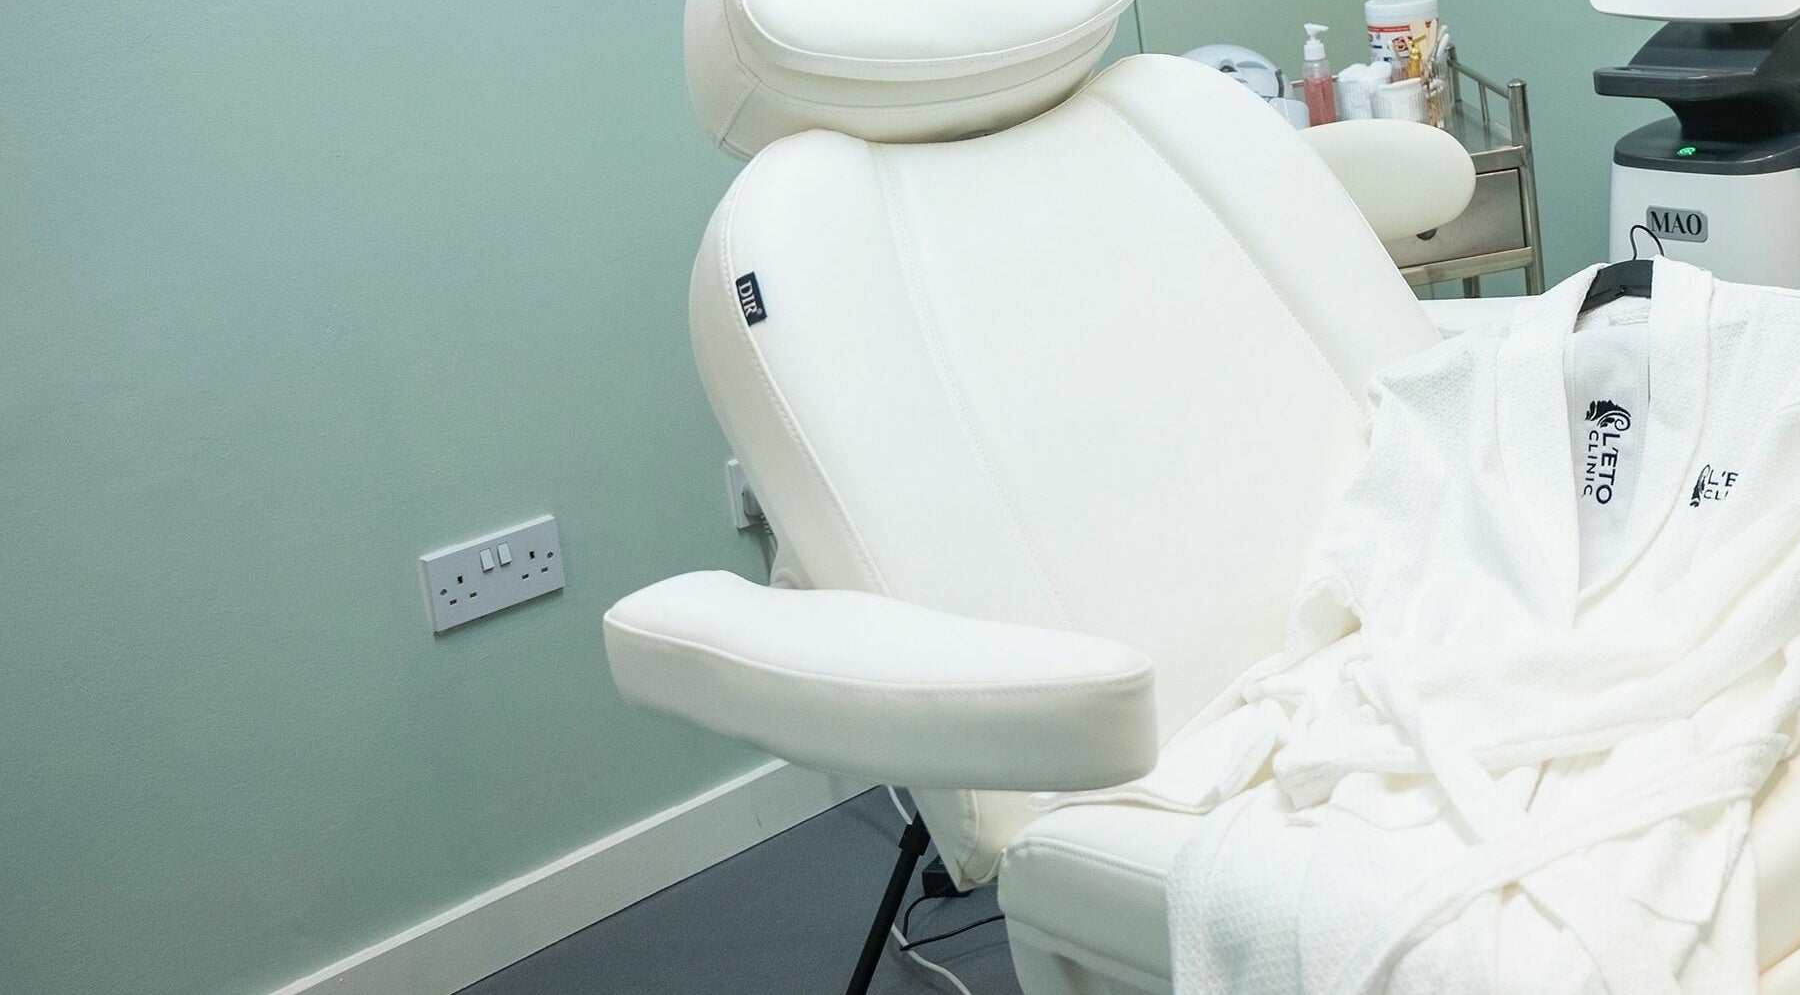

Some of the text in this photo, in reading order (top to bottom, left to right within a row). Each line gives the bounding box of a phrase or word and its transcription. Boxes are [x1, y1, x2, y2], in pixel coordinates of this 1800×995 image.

[1650, 211, 1702, 235] MAO
[1582, 430, 1599, 497] CLINIC
[1596, 433, 1620, 504] L'ETO
